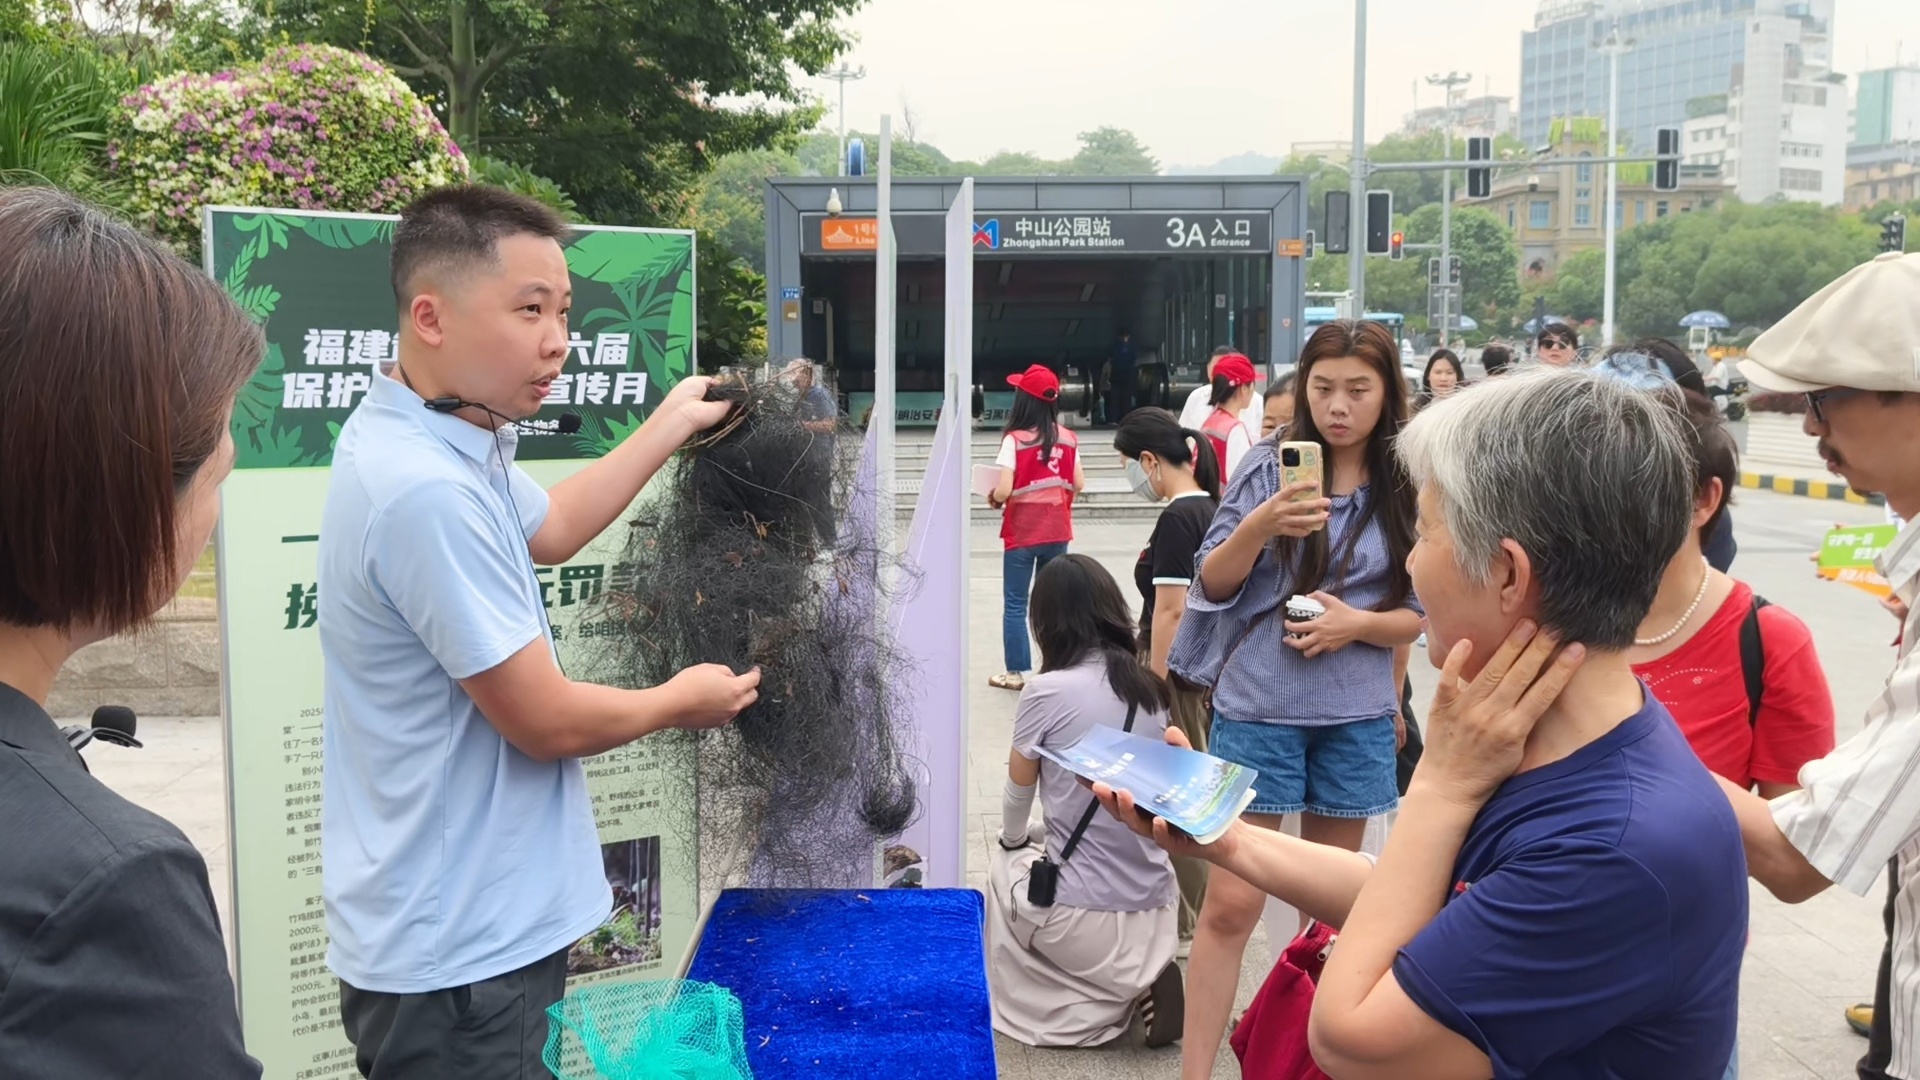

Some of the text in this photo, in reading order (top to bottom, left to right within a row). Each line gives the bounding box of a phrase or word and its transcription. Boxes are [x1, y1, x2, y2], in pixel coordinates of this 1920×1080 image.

[1015, 217, 1111, 237] 中山公园站
[1166, 217, 1206, 247] 3A
[1211, 218, 1250, 235] 入口
[1003, 238, 1060, 248] Zhongshan
[1062, 238, 1085, 247] Park
[1088, 238, 1124, 247] Station
[1210, 238, 1250, 246] Entrance
[282, 372, 648, 408] 保护 宣传月
[302, 765, 323, 776] 别小
[285, 794, 324, 807] 家明令禁
